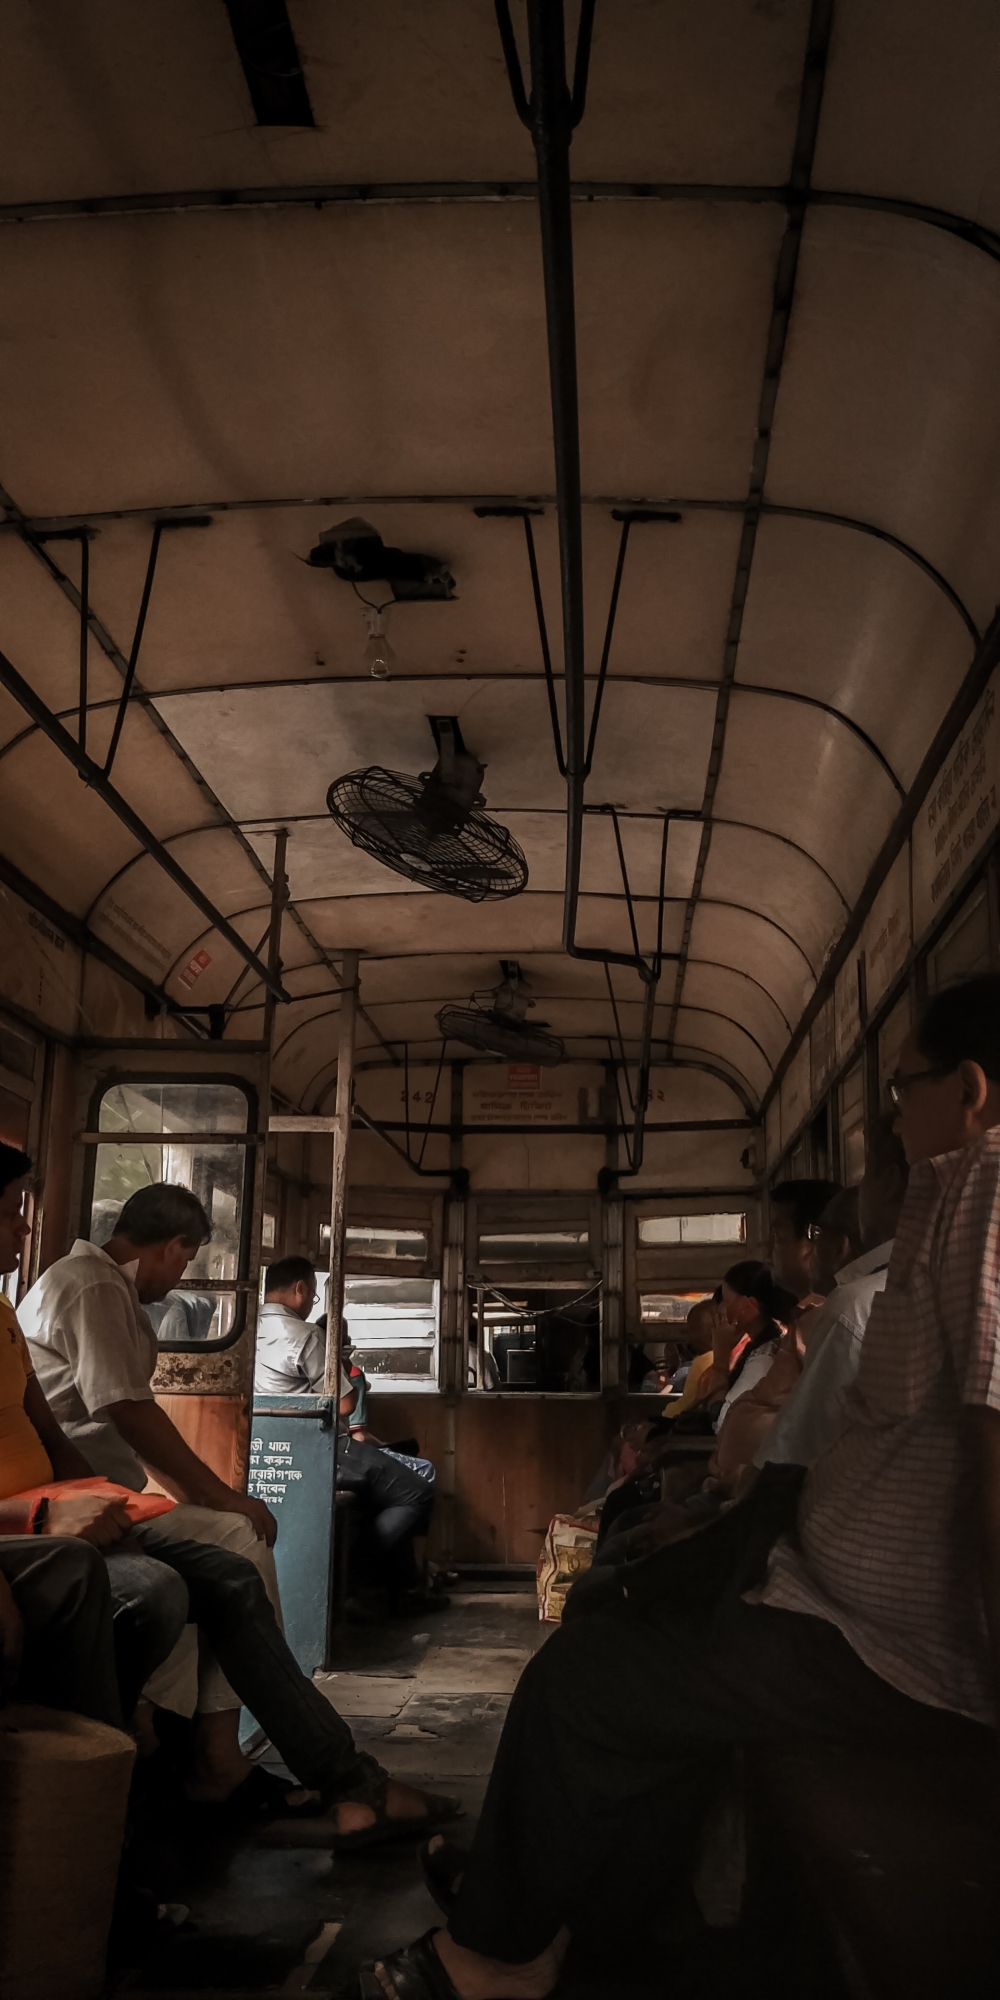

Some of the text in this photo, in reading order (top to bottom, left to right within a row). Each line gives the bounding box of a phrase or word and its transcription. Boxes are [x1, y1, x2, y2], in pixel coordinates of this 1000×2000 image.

[399, 1089, 433, 1103] 242
[268, 1441, 291, 1452] থামে
[262, 1455, 293, 1466] করুন
[255, 1479, 287, 1493] দিবেন
